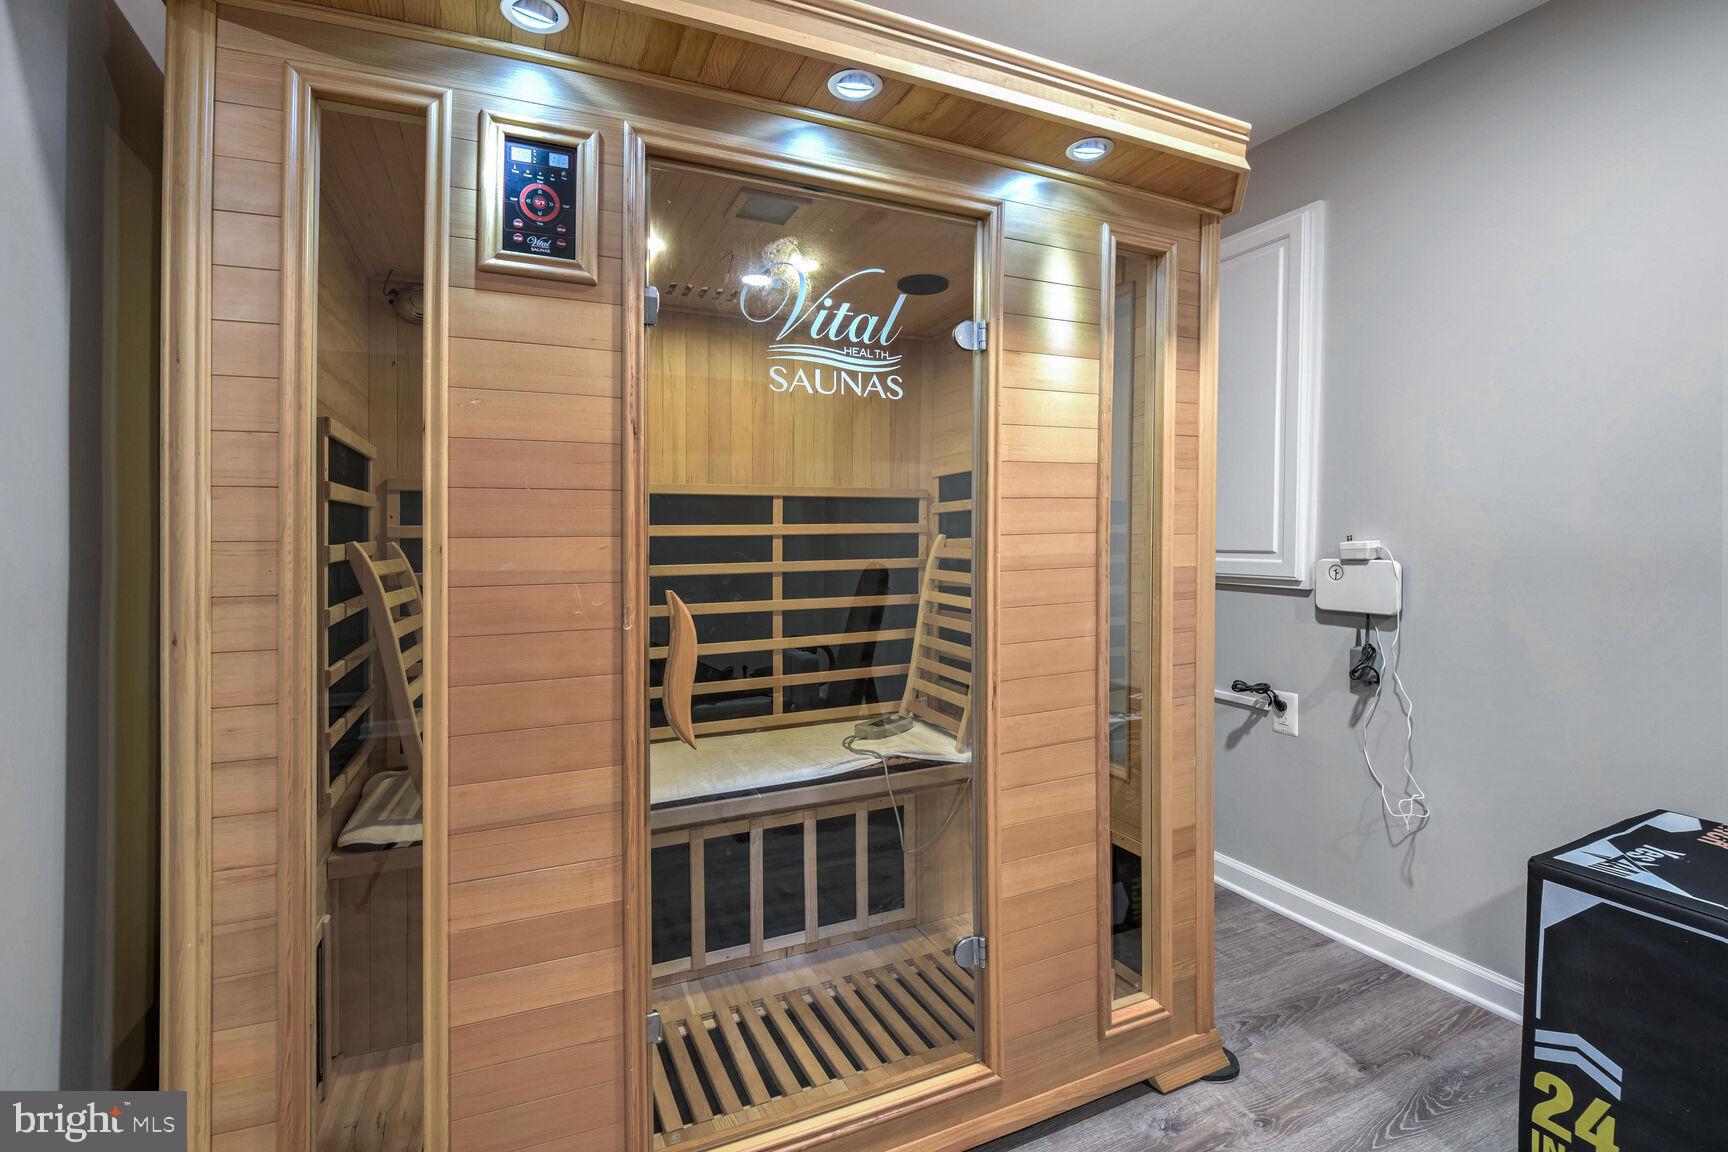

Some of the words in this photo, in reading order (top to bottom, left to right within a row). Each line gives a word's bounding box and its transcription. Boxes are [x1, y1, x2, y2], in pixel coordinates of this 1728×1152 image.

[527, 236, 551, 247] Vital
[740, 262, 907, 346] Vital
[844, 346, 889, 359] HEALTH
[769, 366, 904, 399] SAUNAS
[1531, 1071, 1620, 1152] 24
